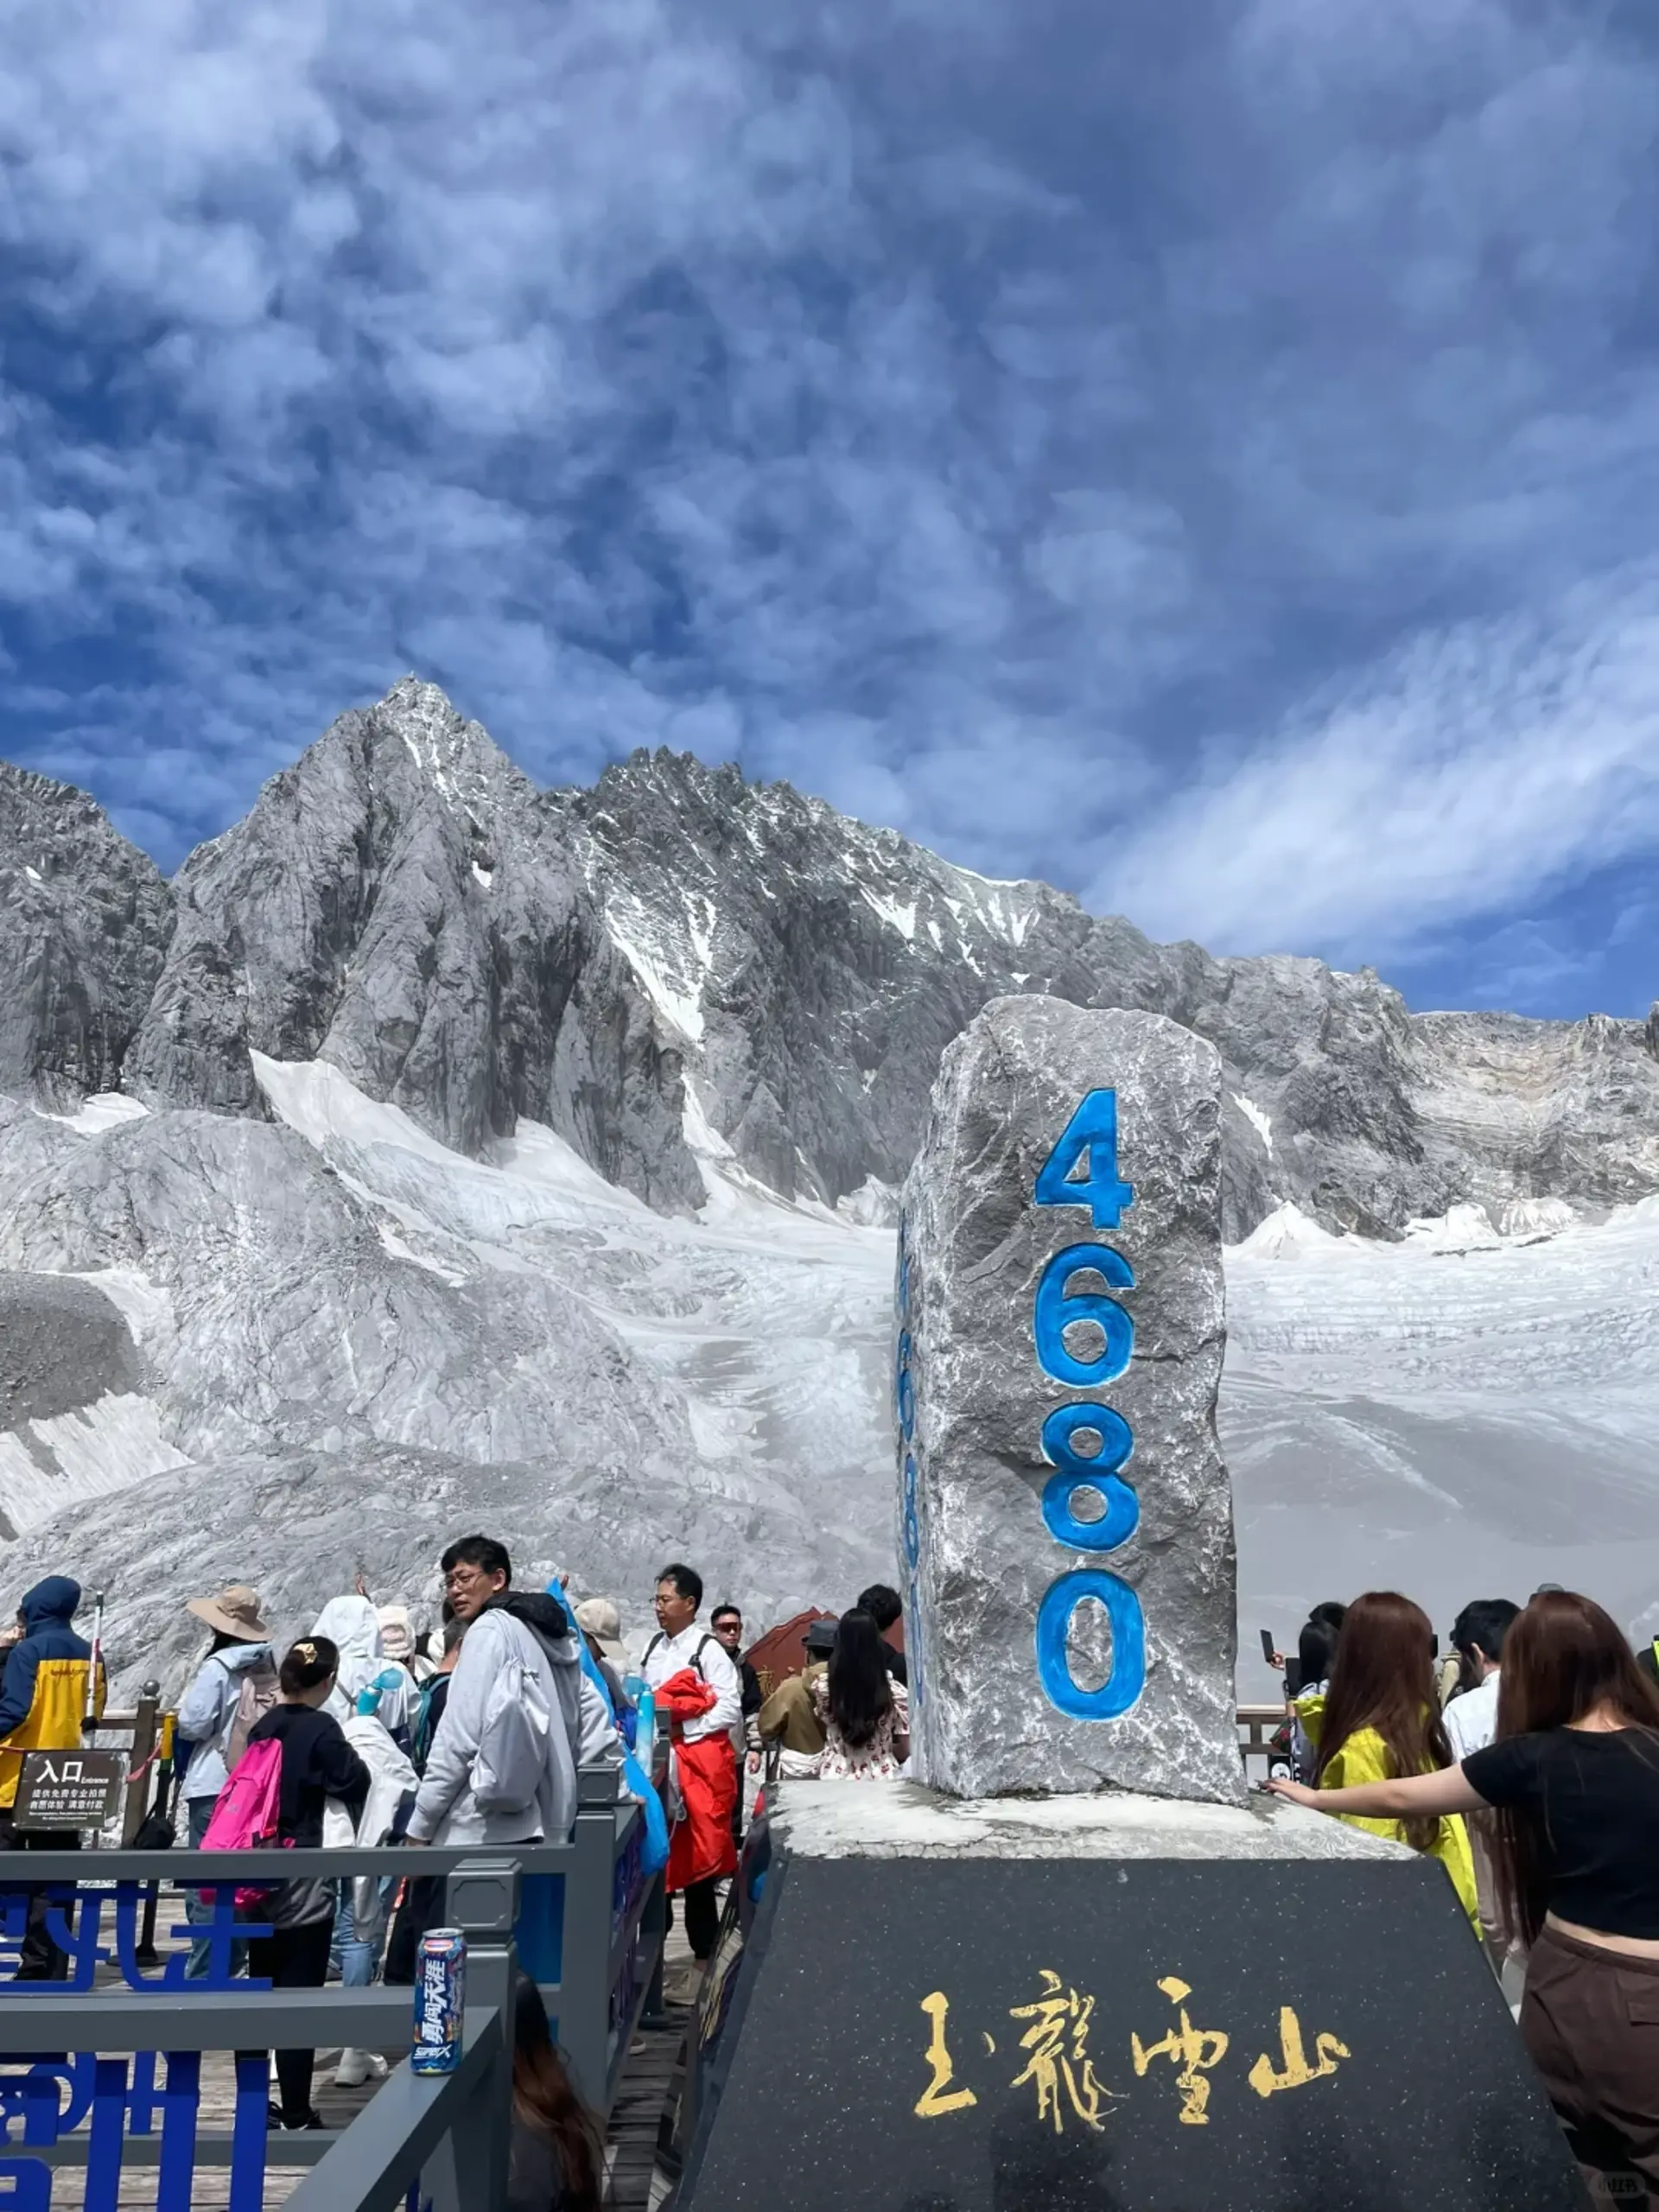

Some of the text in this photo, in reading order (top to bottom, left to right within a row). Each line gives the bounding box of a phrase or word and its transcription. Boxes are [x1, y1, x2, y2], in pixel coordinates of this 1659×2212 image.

[1034, 1086, 1146, 1722] 4680
[35, 1759, 84, 1783] 入口
[421, 1958, 447, 2045] 勇闯天涯
